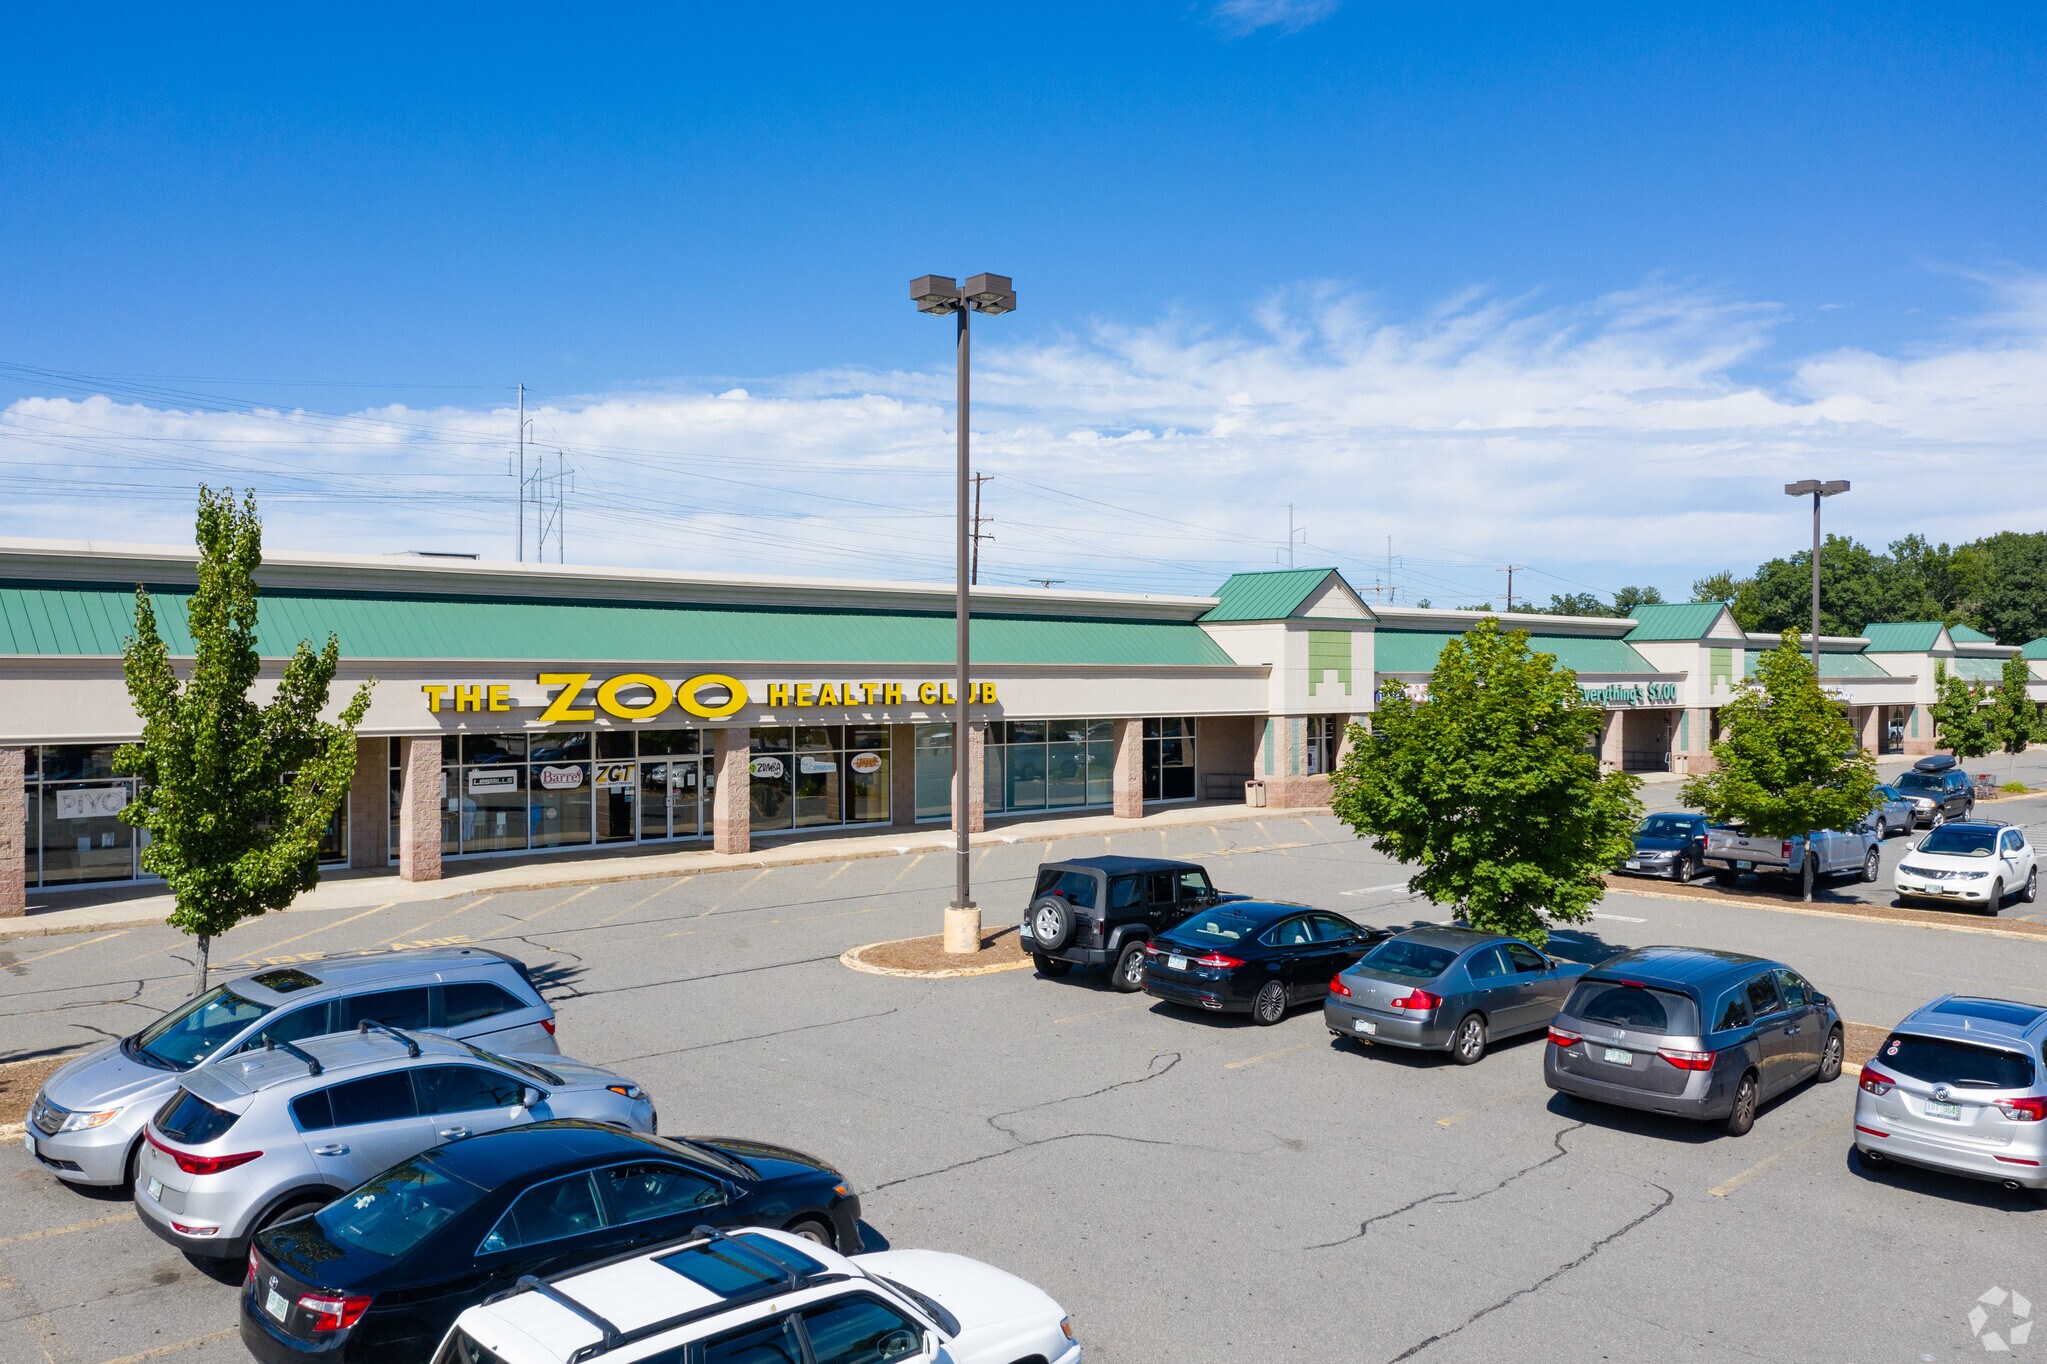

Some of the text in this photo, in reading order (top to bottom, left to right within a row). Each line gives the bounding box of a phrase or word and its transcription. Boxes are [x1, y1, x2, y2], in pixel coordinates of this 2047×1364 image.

[421, 685, 510, 713] THE
[536, 673, 748, 721] ZOO
[767, 683, 902, 707] HEALTH
[596, 765, 635, 782] ZGT
